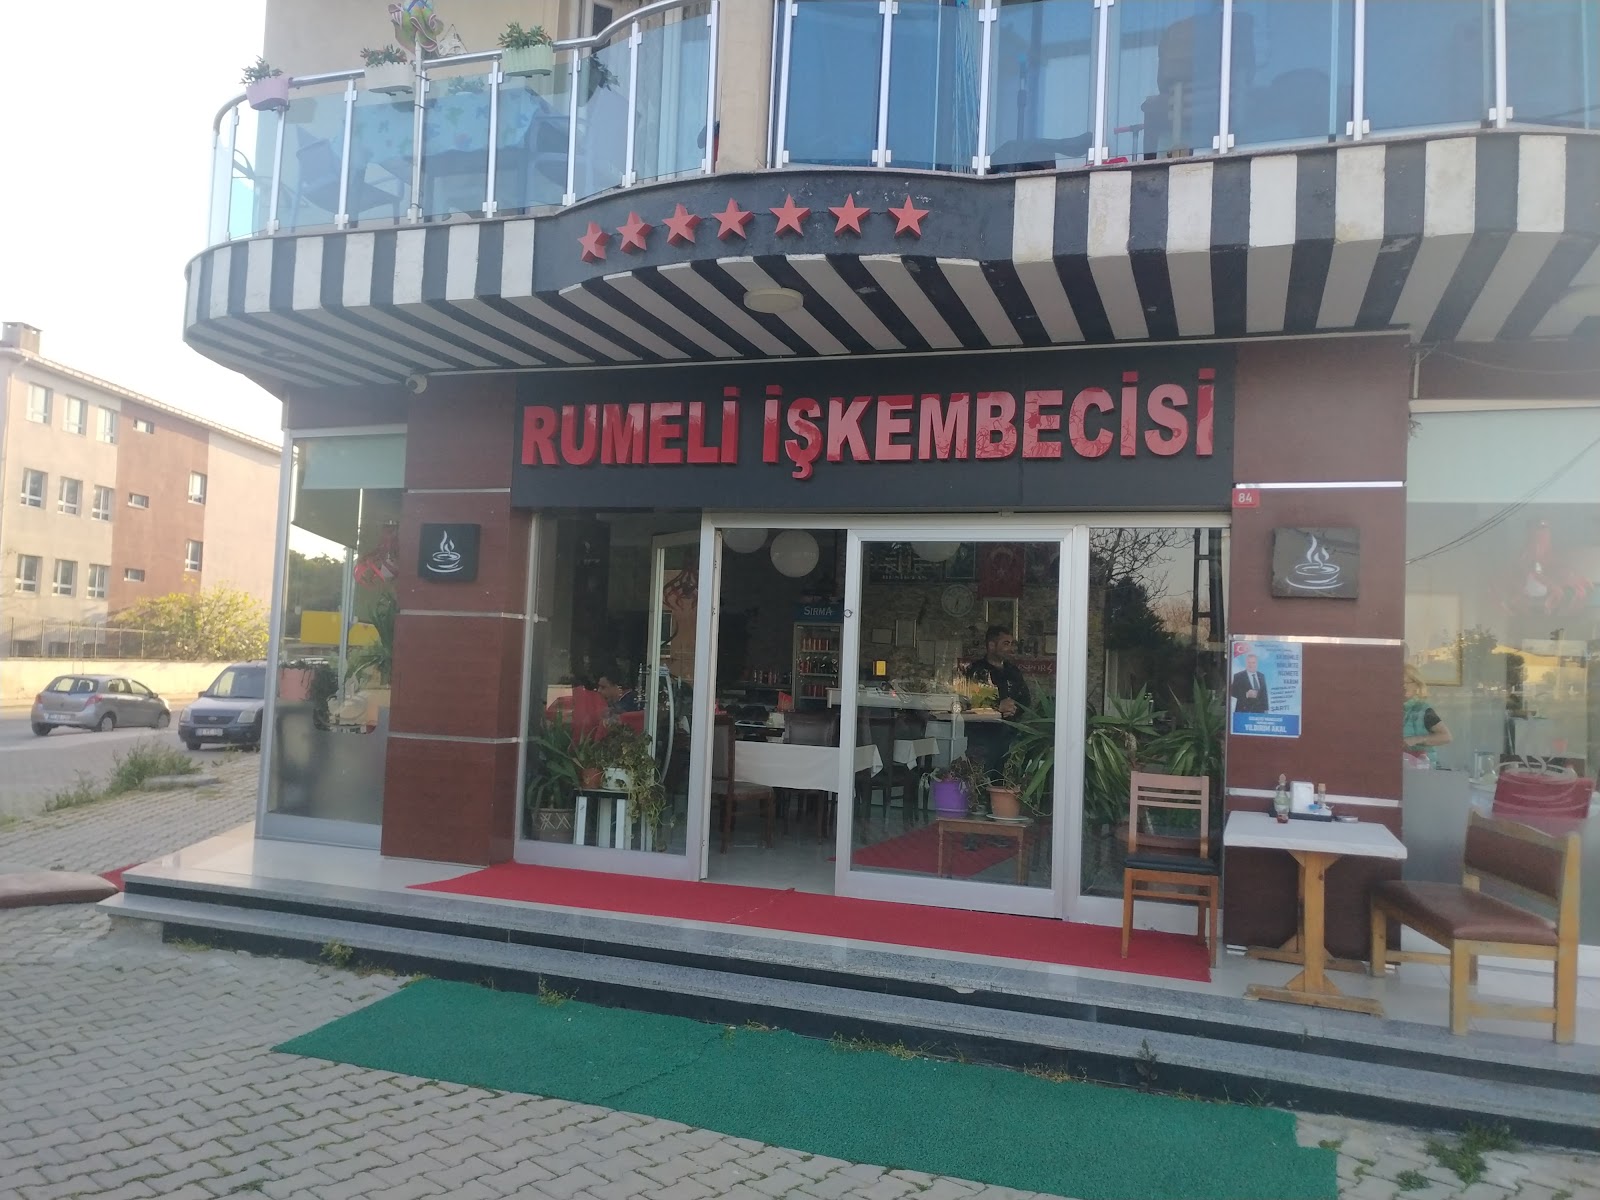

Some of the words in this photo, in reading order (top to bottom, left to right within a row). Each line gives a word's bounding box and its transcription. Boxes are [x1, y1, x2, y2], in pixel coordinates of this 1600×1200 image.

[521, 386, 739, 465] RUMELİ
[762, 367, 1216, 480] İŞKEMBECİSİ
[1238, 492, 1253, 503] 84
